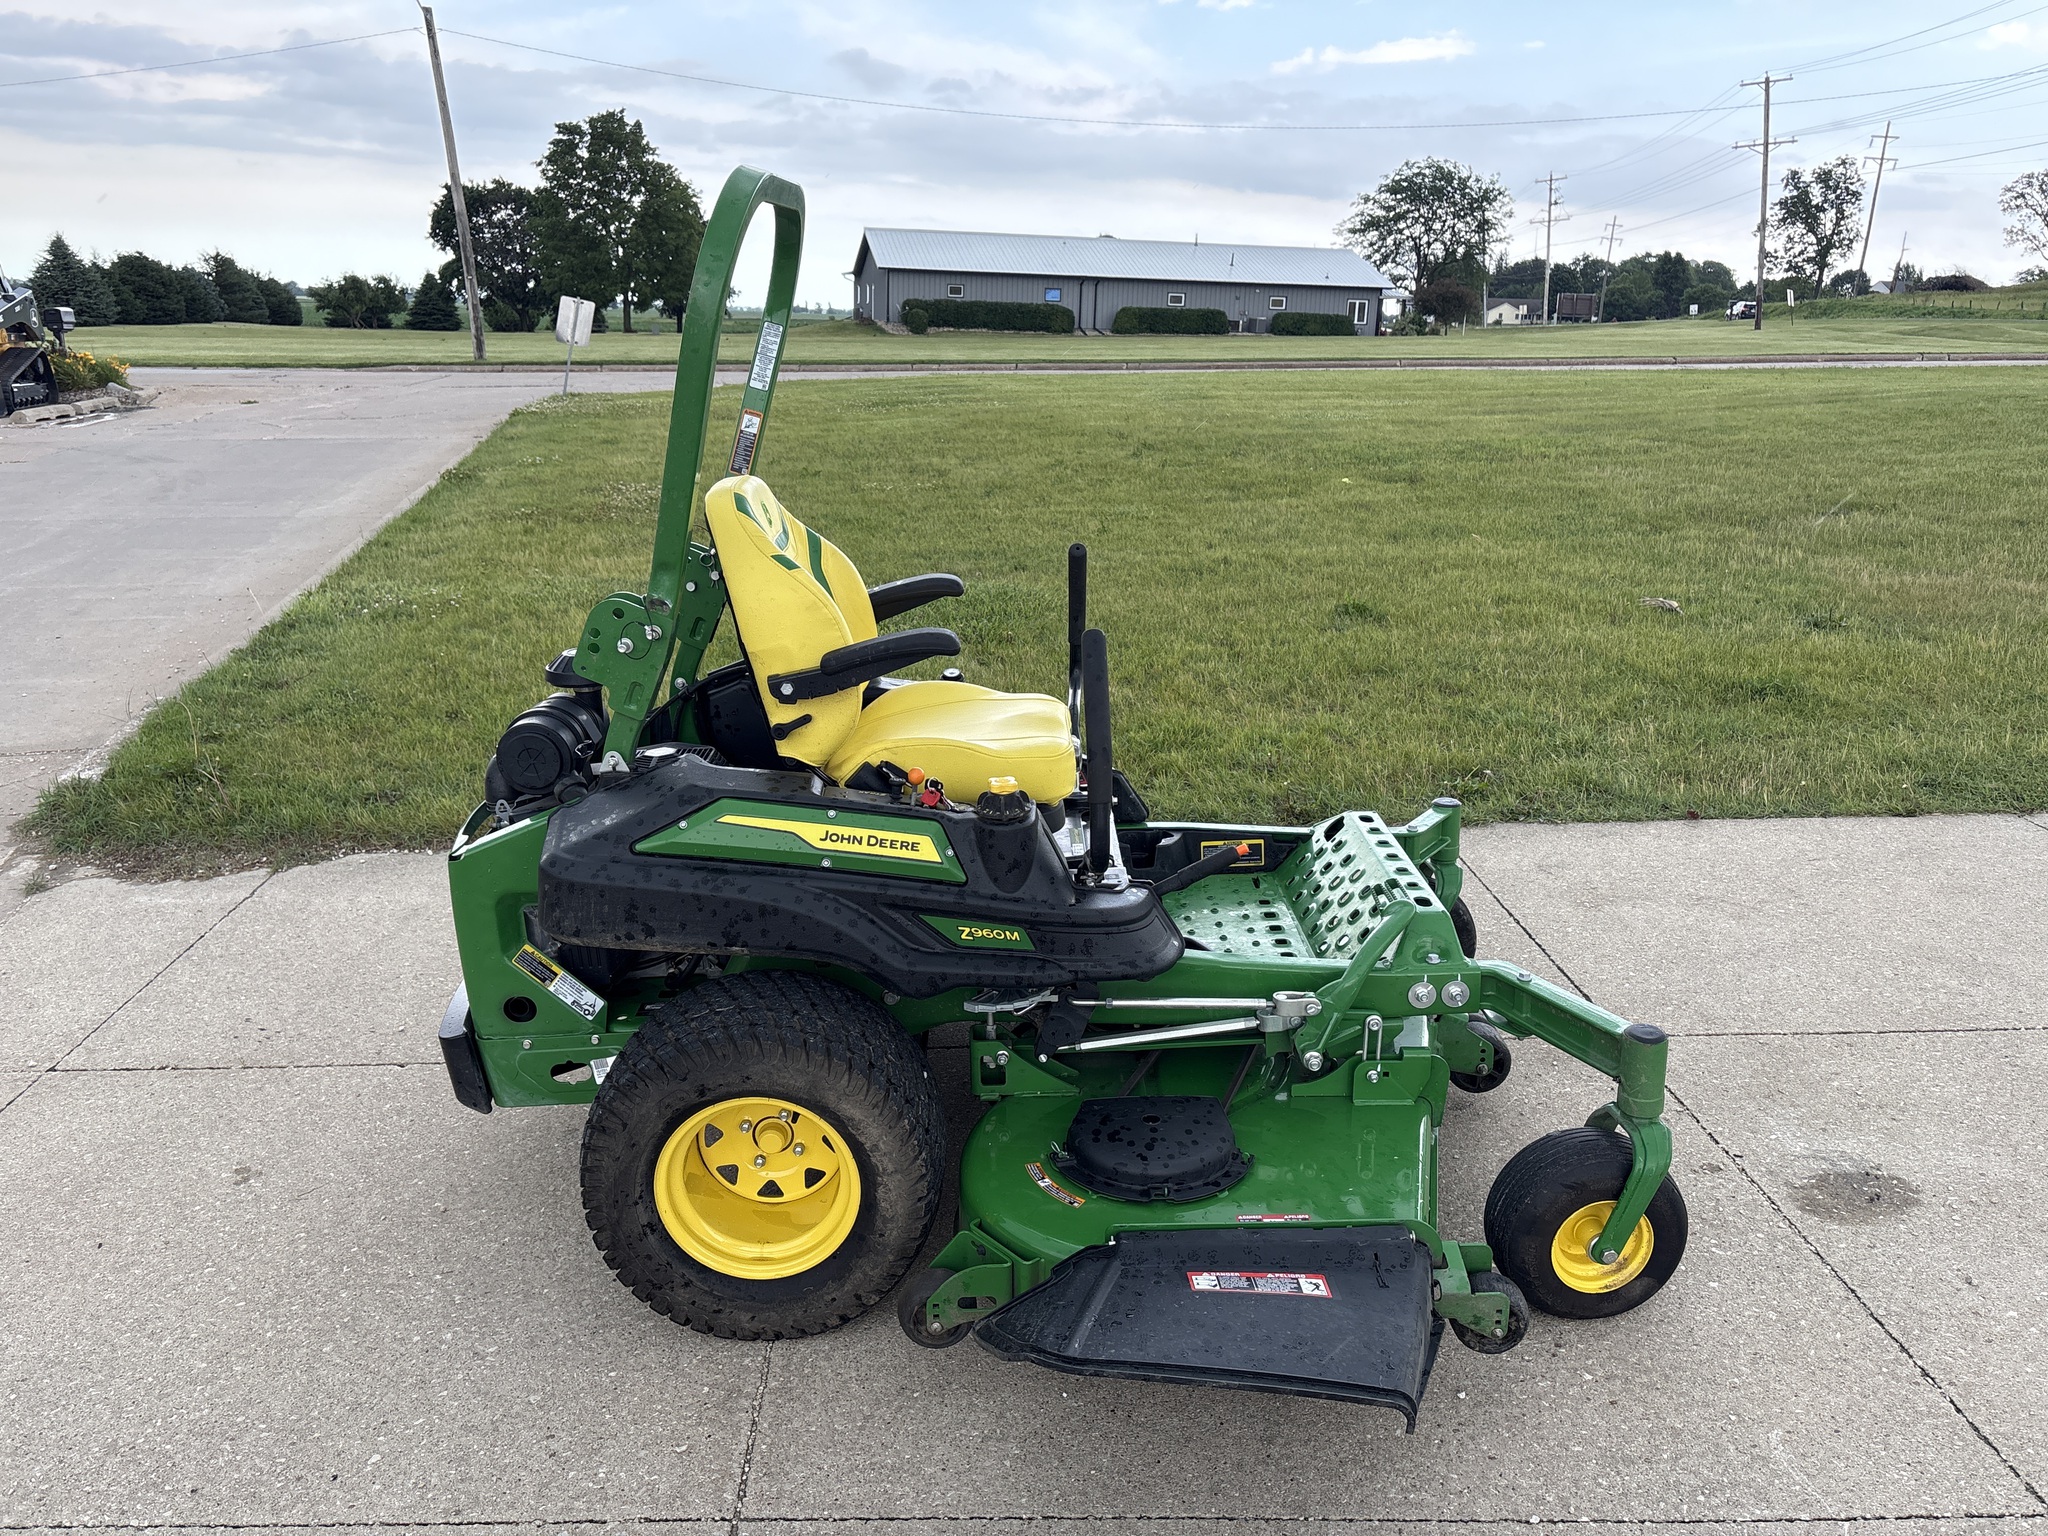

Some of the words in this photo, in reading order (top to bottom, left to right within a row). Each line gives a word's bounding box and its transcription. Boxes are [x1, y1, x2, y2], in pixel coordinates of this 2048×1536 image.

[819, 830, 863, 846] JOHN
[867, 834, 921, 852] DEERE
[957, 926, 1021, 941] Z960M
[535, 953, 554, 969] CAUTION
